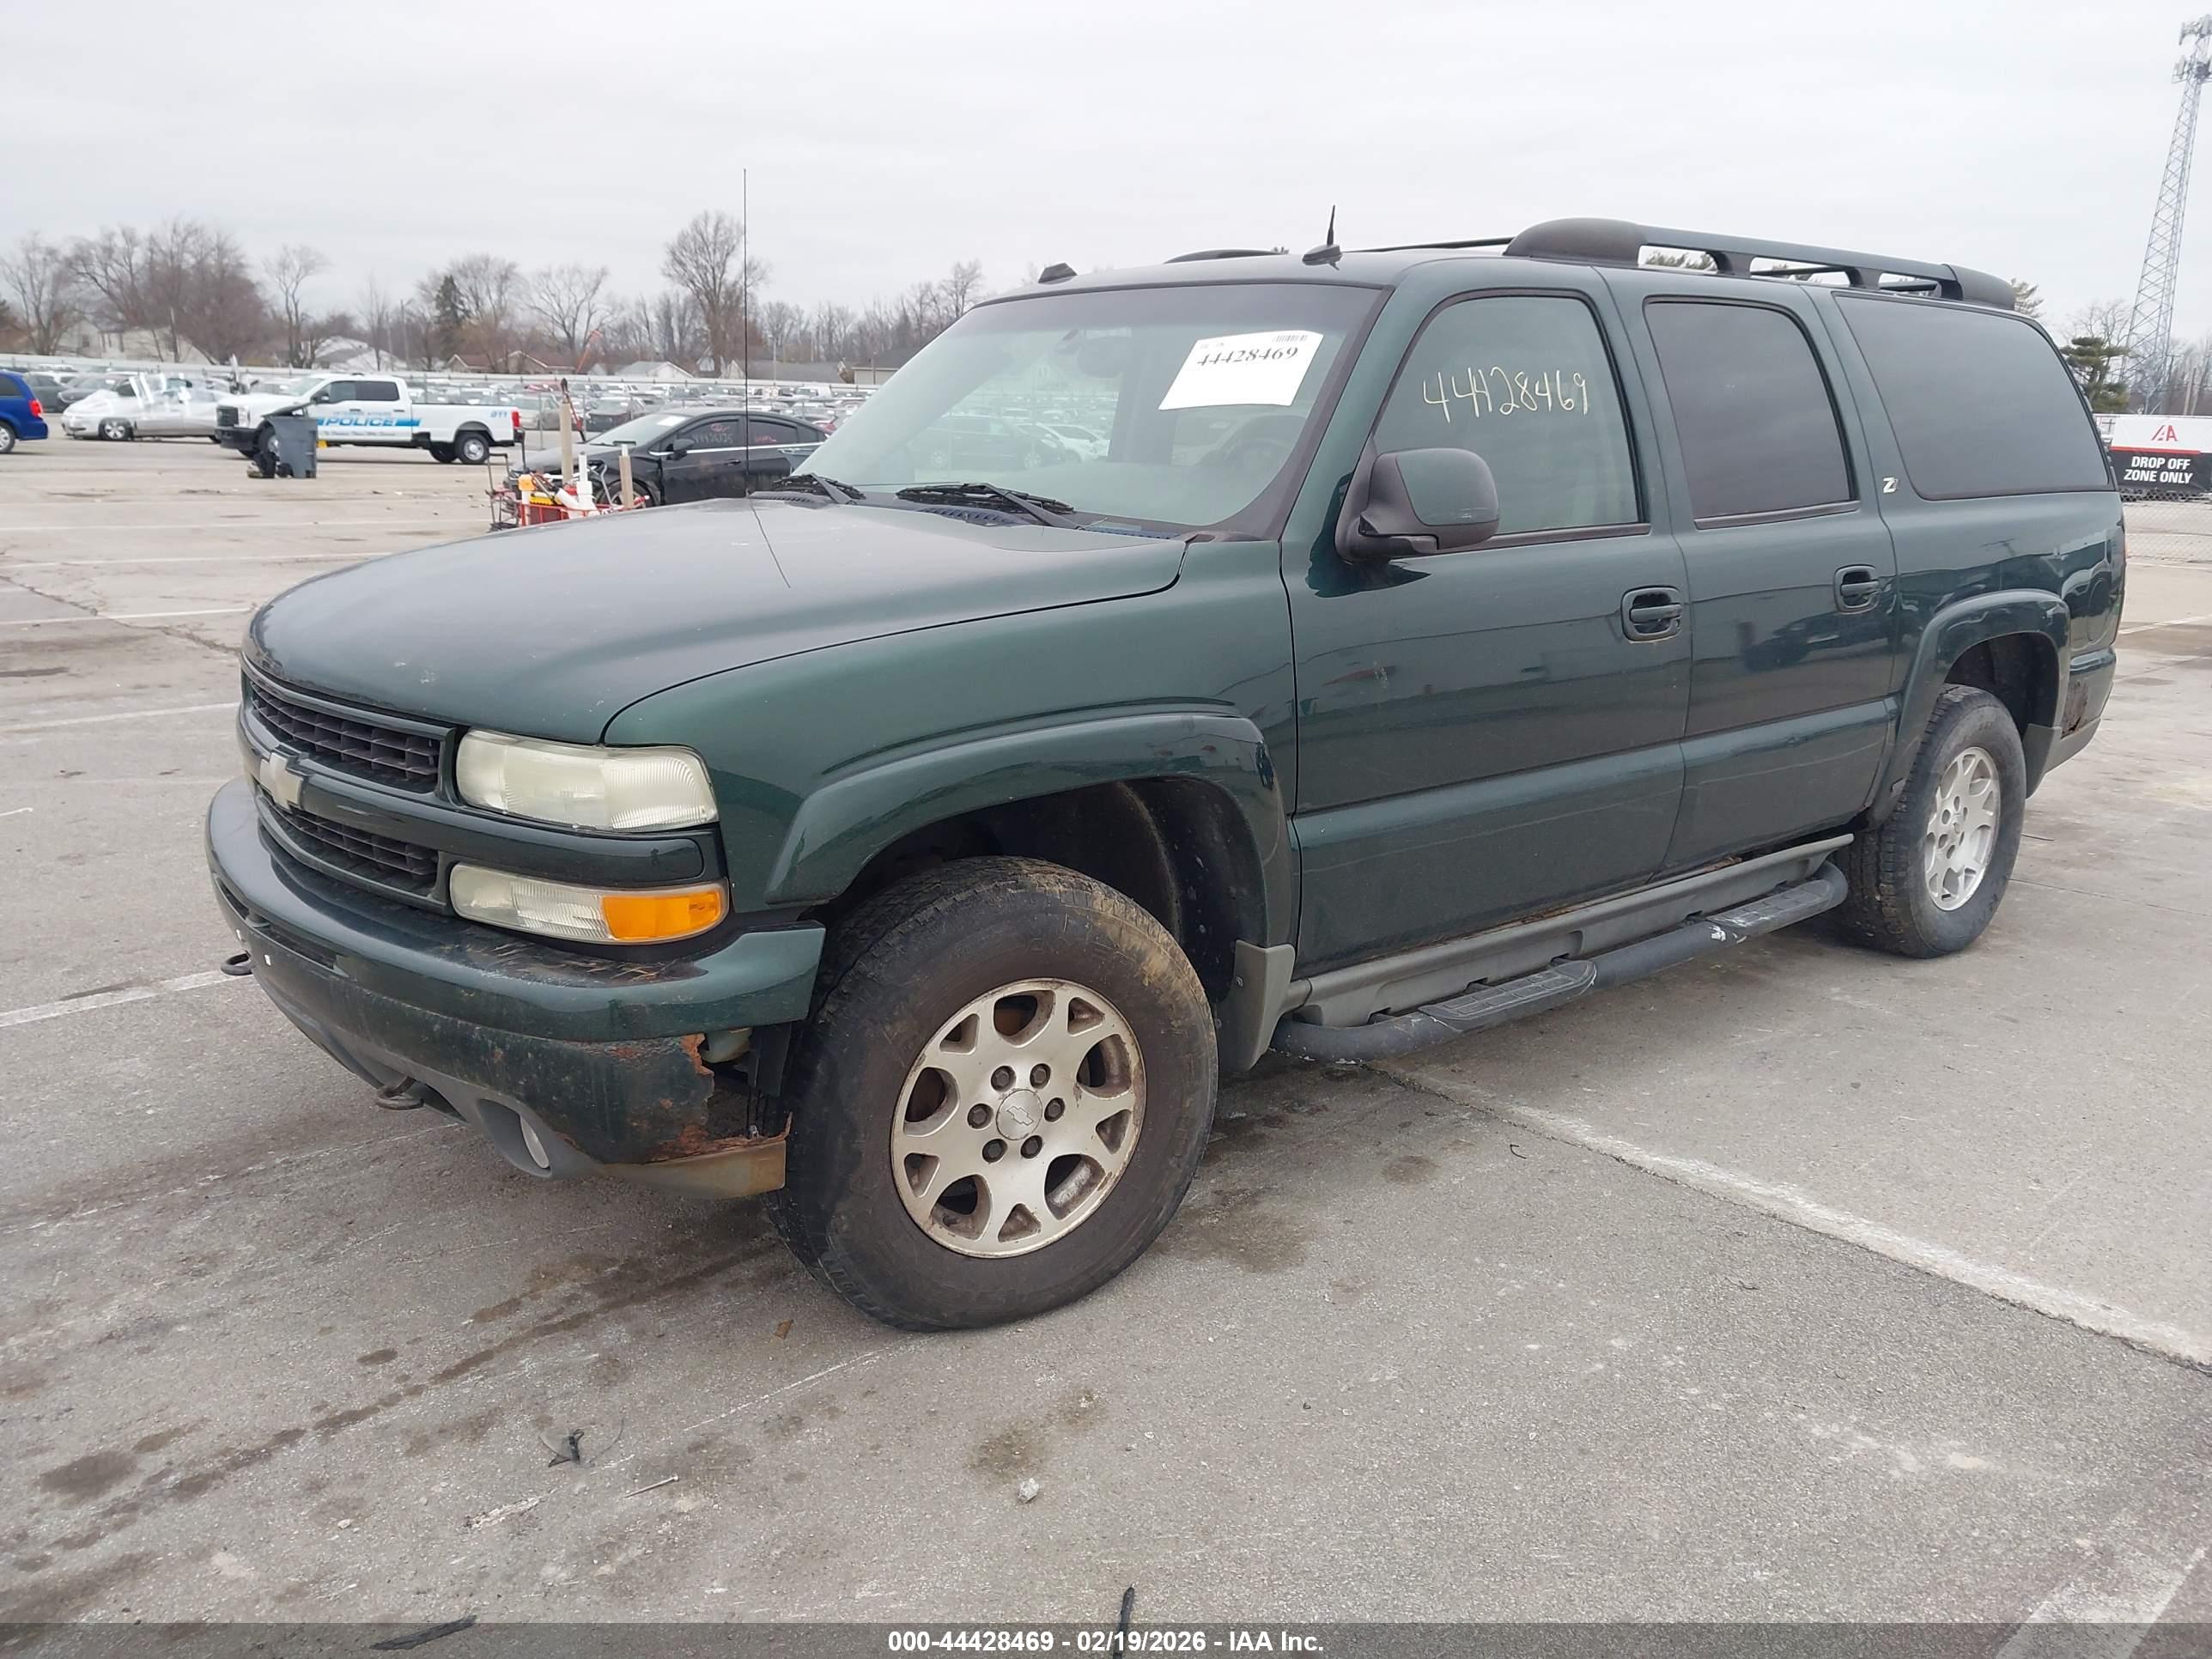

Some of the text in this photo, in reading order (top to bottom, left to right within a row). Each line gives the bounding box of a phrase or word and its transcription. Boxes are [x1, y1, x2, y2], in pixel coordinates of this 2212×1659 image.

[1197, 347, 1298, 366] 44428469
[1422, 366, 1588, 423] 44428469
[325, 417, 394, 427] POLICE
[2131, 456, 2191, 470] DROP OFF
[2124, 470, 2193, 484] ZONE ONLY
